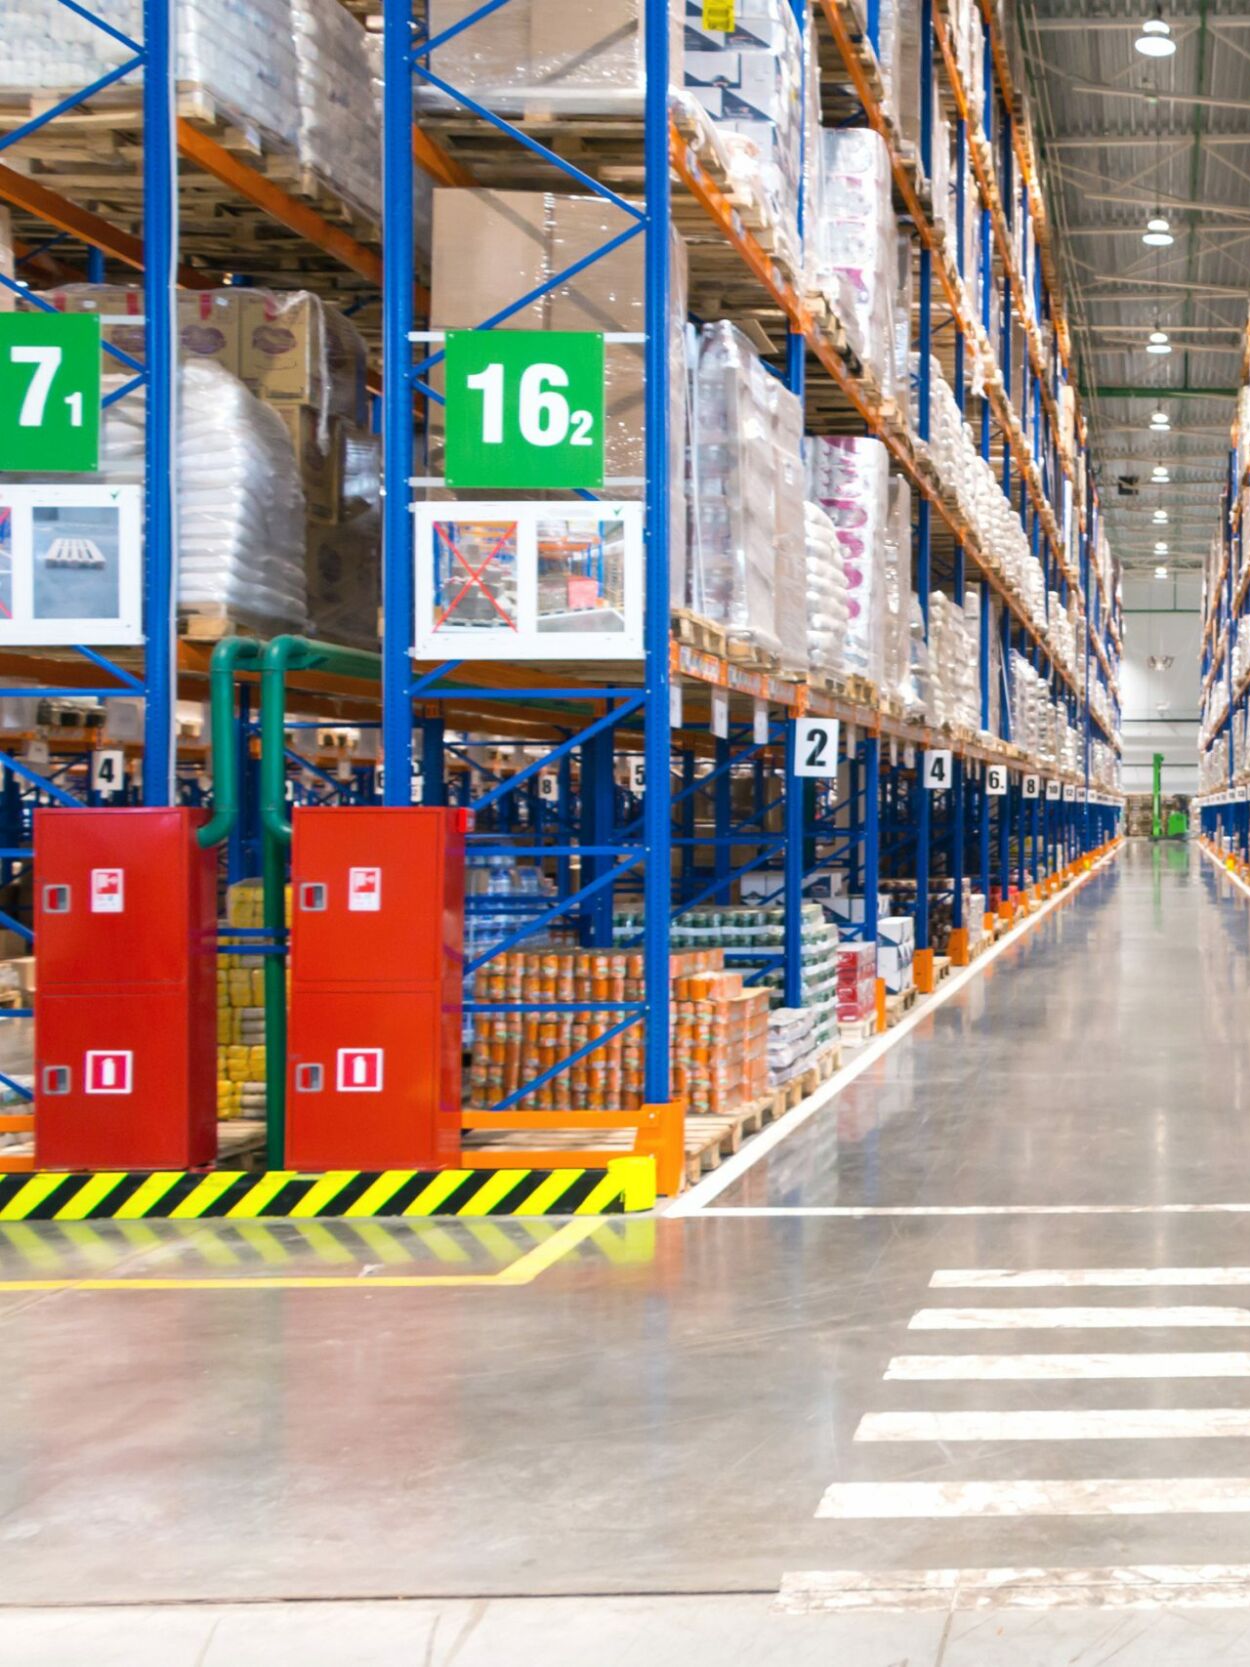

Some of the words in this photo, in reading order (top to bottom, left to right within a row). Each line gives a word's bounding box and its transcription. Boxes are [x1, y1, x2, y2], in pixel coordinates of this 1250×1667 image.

[805, 728, 828, 767] 2
[98, 757, 114, 783] 4
[635, 764, 645, 786] 5
[929, 756, 946, 782] 4
[1026, 778, 1036, 794] 8
